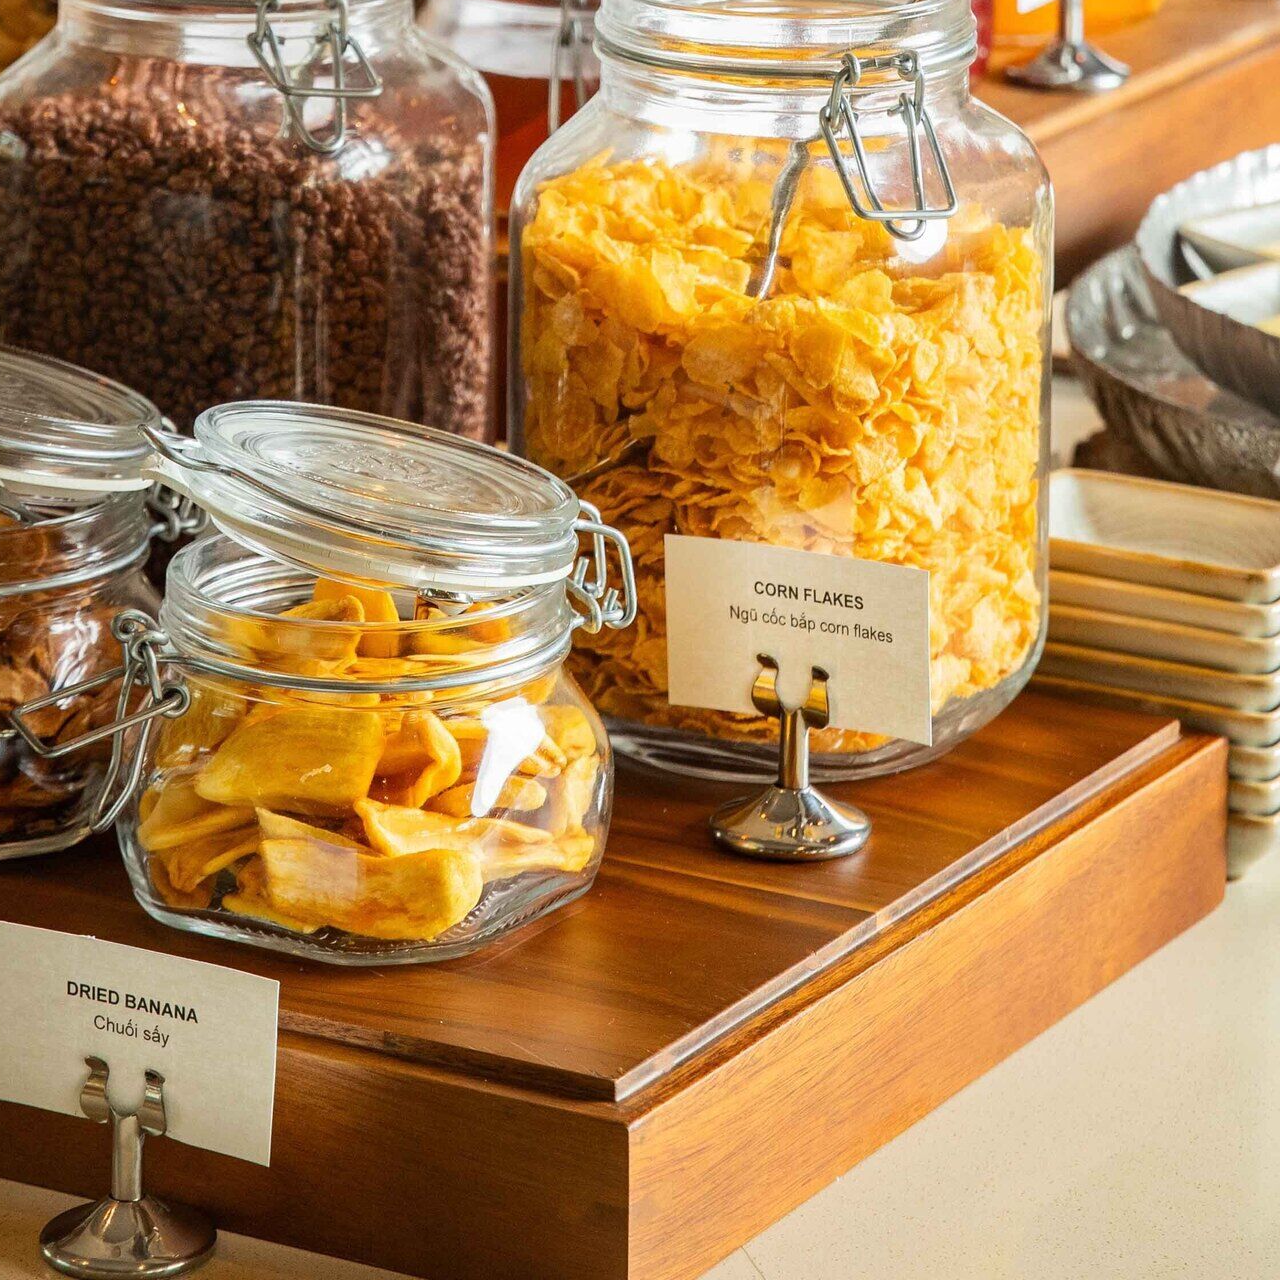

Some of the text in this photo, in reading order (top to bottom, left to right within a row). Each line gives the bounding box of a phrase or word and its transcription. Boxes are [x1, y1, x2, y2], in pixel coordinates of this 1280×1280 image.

[754, 581, 864, 610] CORN FLAKES
[729, 605, 894, 644] Ngũ cốc bắp corn flakes
[66, 980, 199, 1024] DRIED BANANA
[93, 1014, 170, 1048] Chuối sấy
